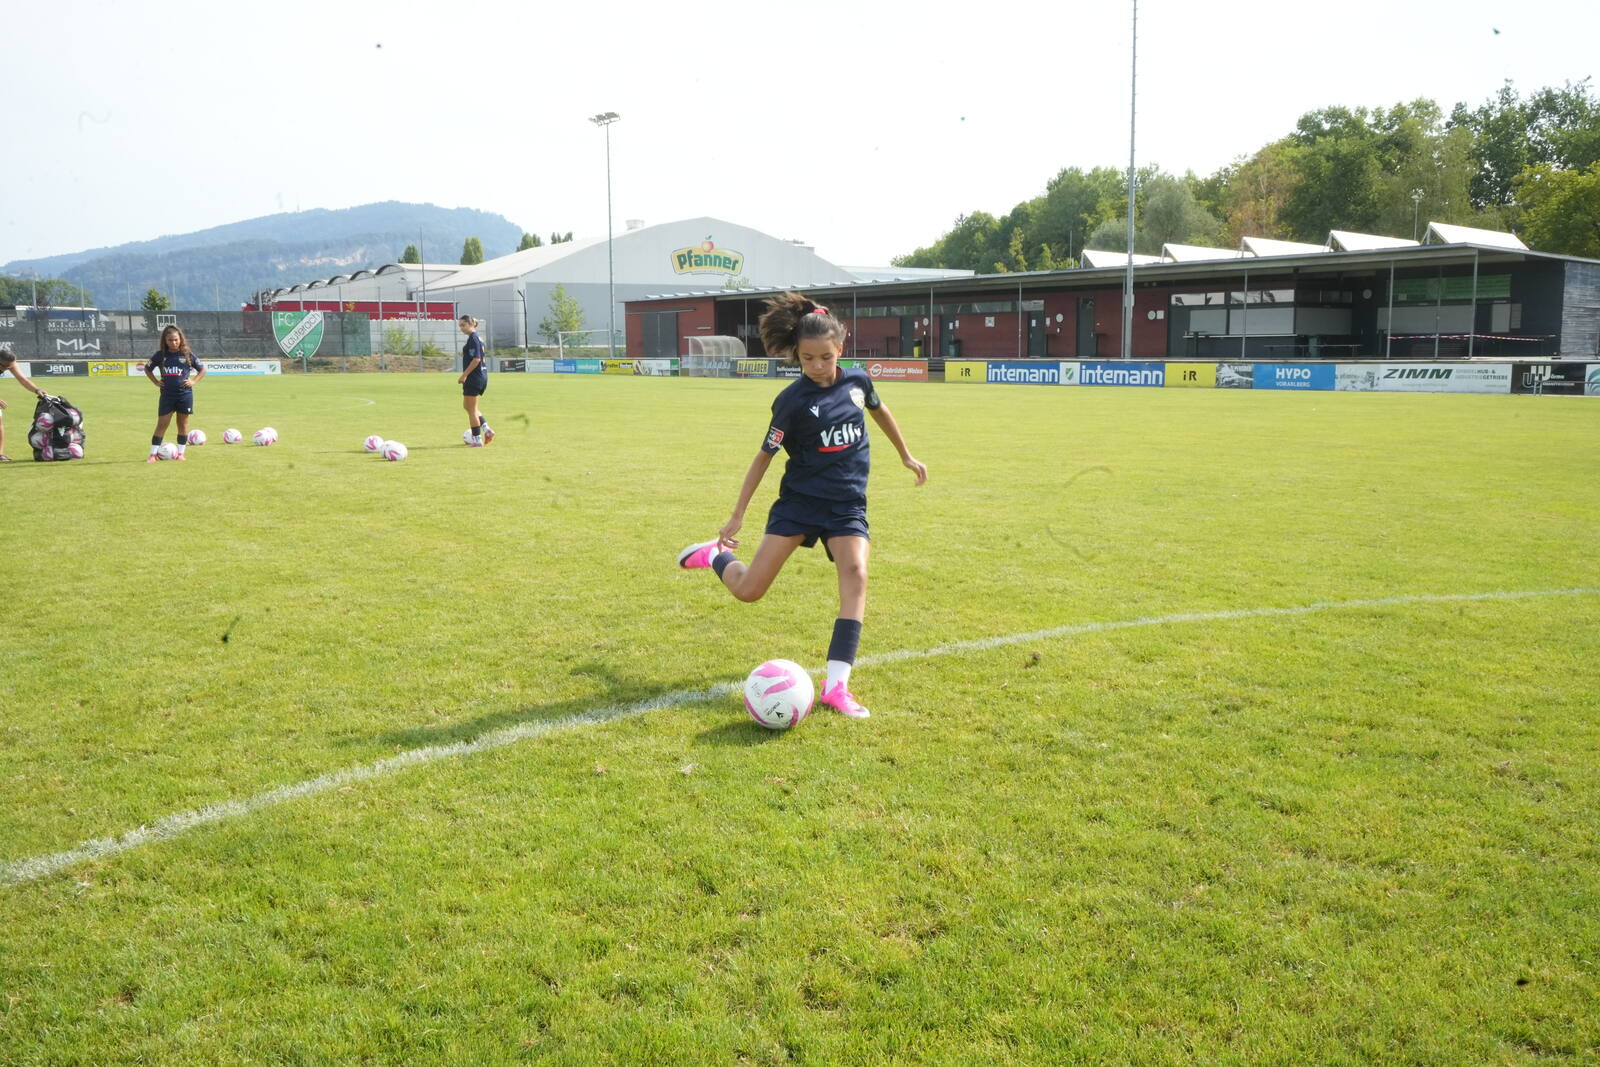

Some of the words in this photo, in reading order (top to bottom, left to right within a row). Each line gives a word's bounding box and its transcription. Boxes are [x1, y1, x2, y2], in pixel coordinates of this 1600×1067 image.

[677, 249, 739, 271] Pfanner
[278, 312, 294, 327] FC
[283, 311, 320, 348] Lauterach
[56, 338, 100, 351] MW
[988, 364, 1058, 382] intemann
[1081, 365, 1163, 385] intemann
[1276, 367, 1312, 379] HYPO
[1383, 368, 1454, 379] ZIMM
